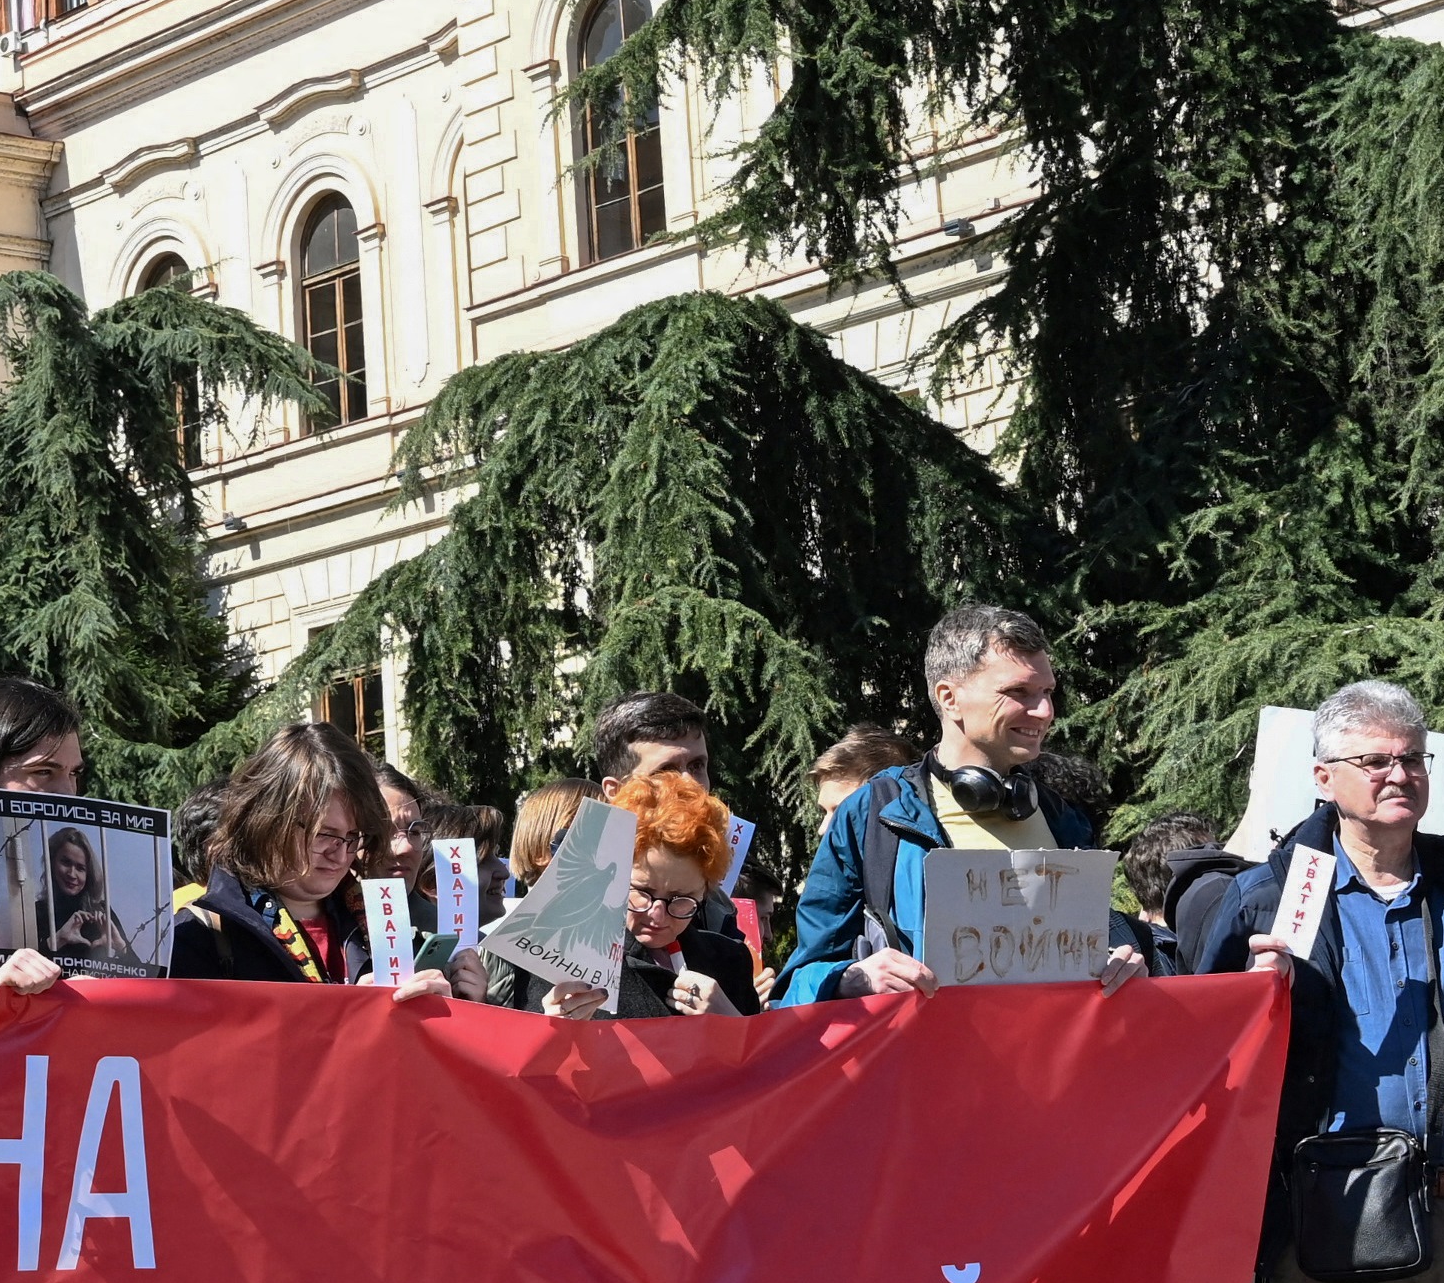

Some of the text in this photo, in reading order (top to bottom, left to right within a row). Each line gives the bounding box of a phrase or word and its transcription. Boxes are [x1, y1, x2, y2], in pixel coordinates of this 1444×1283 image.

[10, 800, 96, 821] БОРОЛИСЬ
[101, 810, 121, 826] ЗА
[126, 813, 155, 830] МИР
[966, 863, 1080, 912] НЕТ
[1292, 855, 1320, 934] ХВАТИТ
[379, 886, 400, 986] ХВАТИТ
[515, 937, 589, 980] ВОЙНЫ
[591, 970, 602, 985] В
